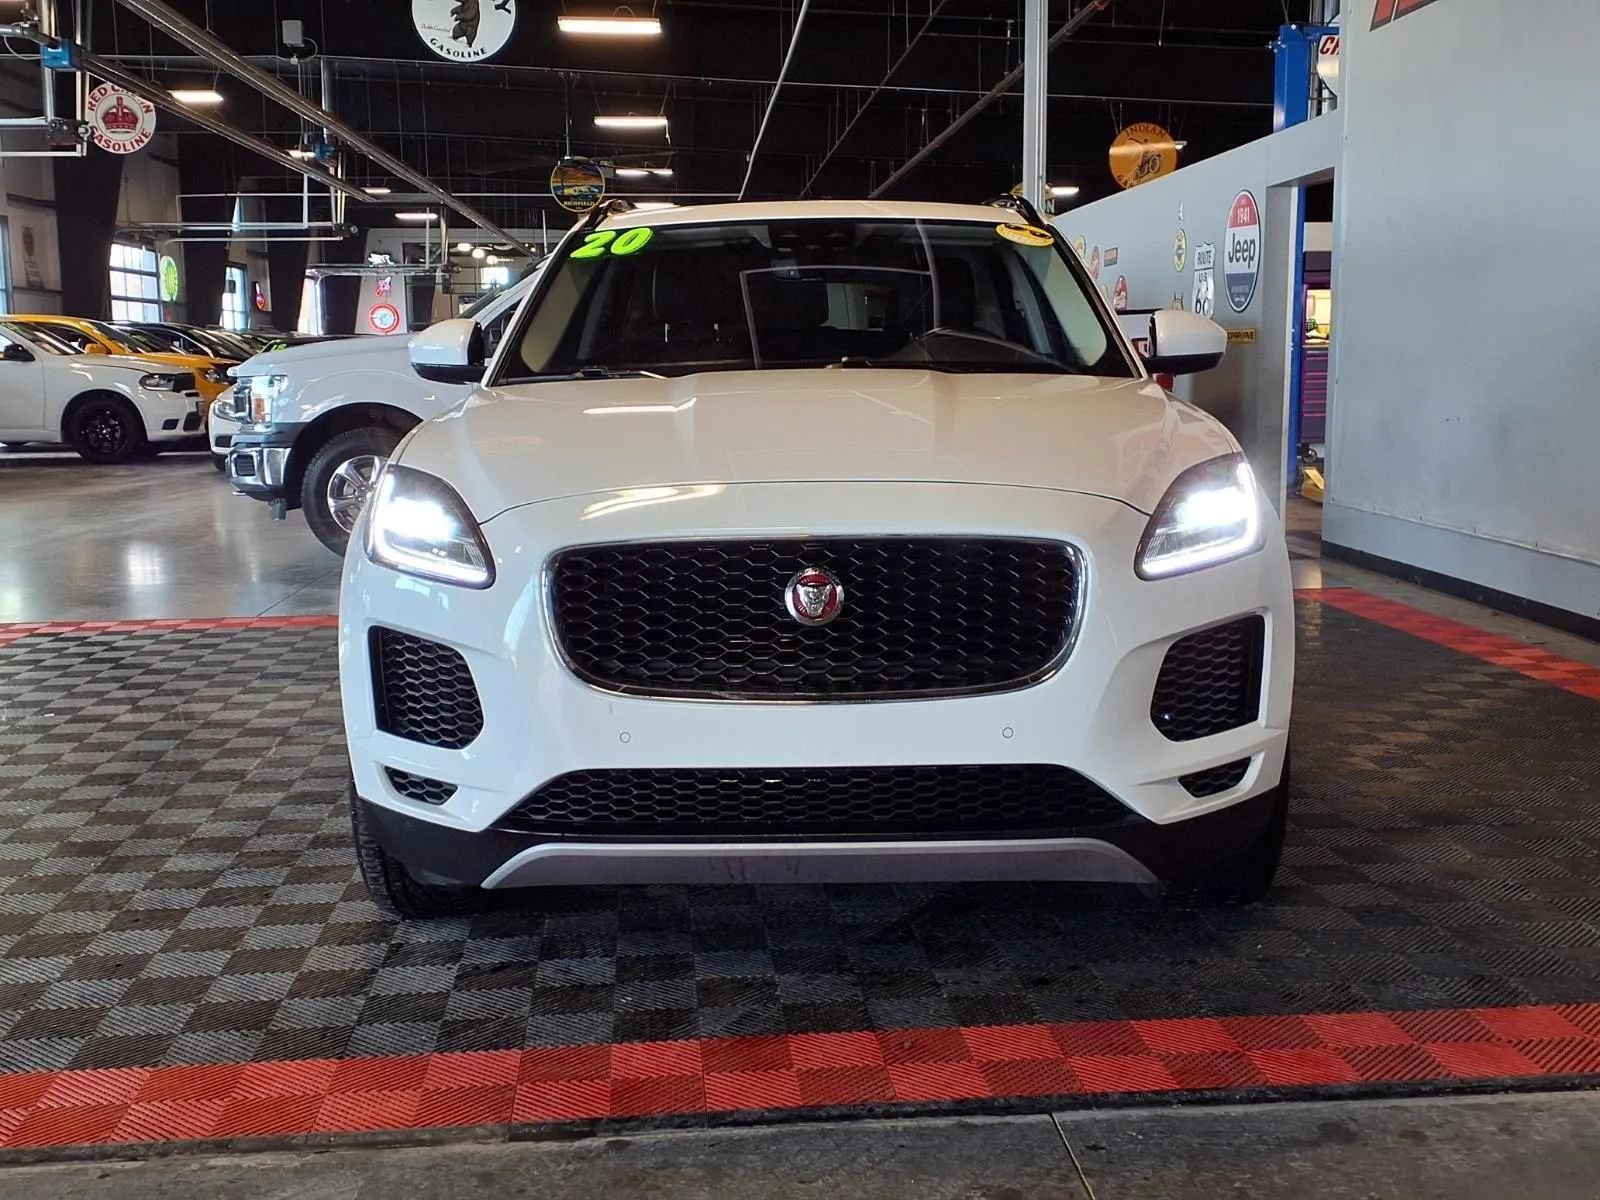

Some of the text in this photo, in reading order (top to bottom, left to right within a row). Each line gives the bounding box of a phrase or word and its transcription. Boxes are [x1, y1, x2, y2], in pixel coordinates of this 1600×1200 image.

[430, 37, 488, 58] GASOLINE
[88, 86, 108, 112] RED
[1126, 124, 1165, 139] INDIAN
[1237, 206, 1250, 224] 1941
[570, 228, 653, 258] 20
[1228, 232, 1256, 269] Jeep
[1197, 250, 1212, 265] ROUTE
